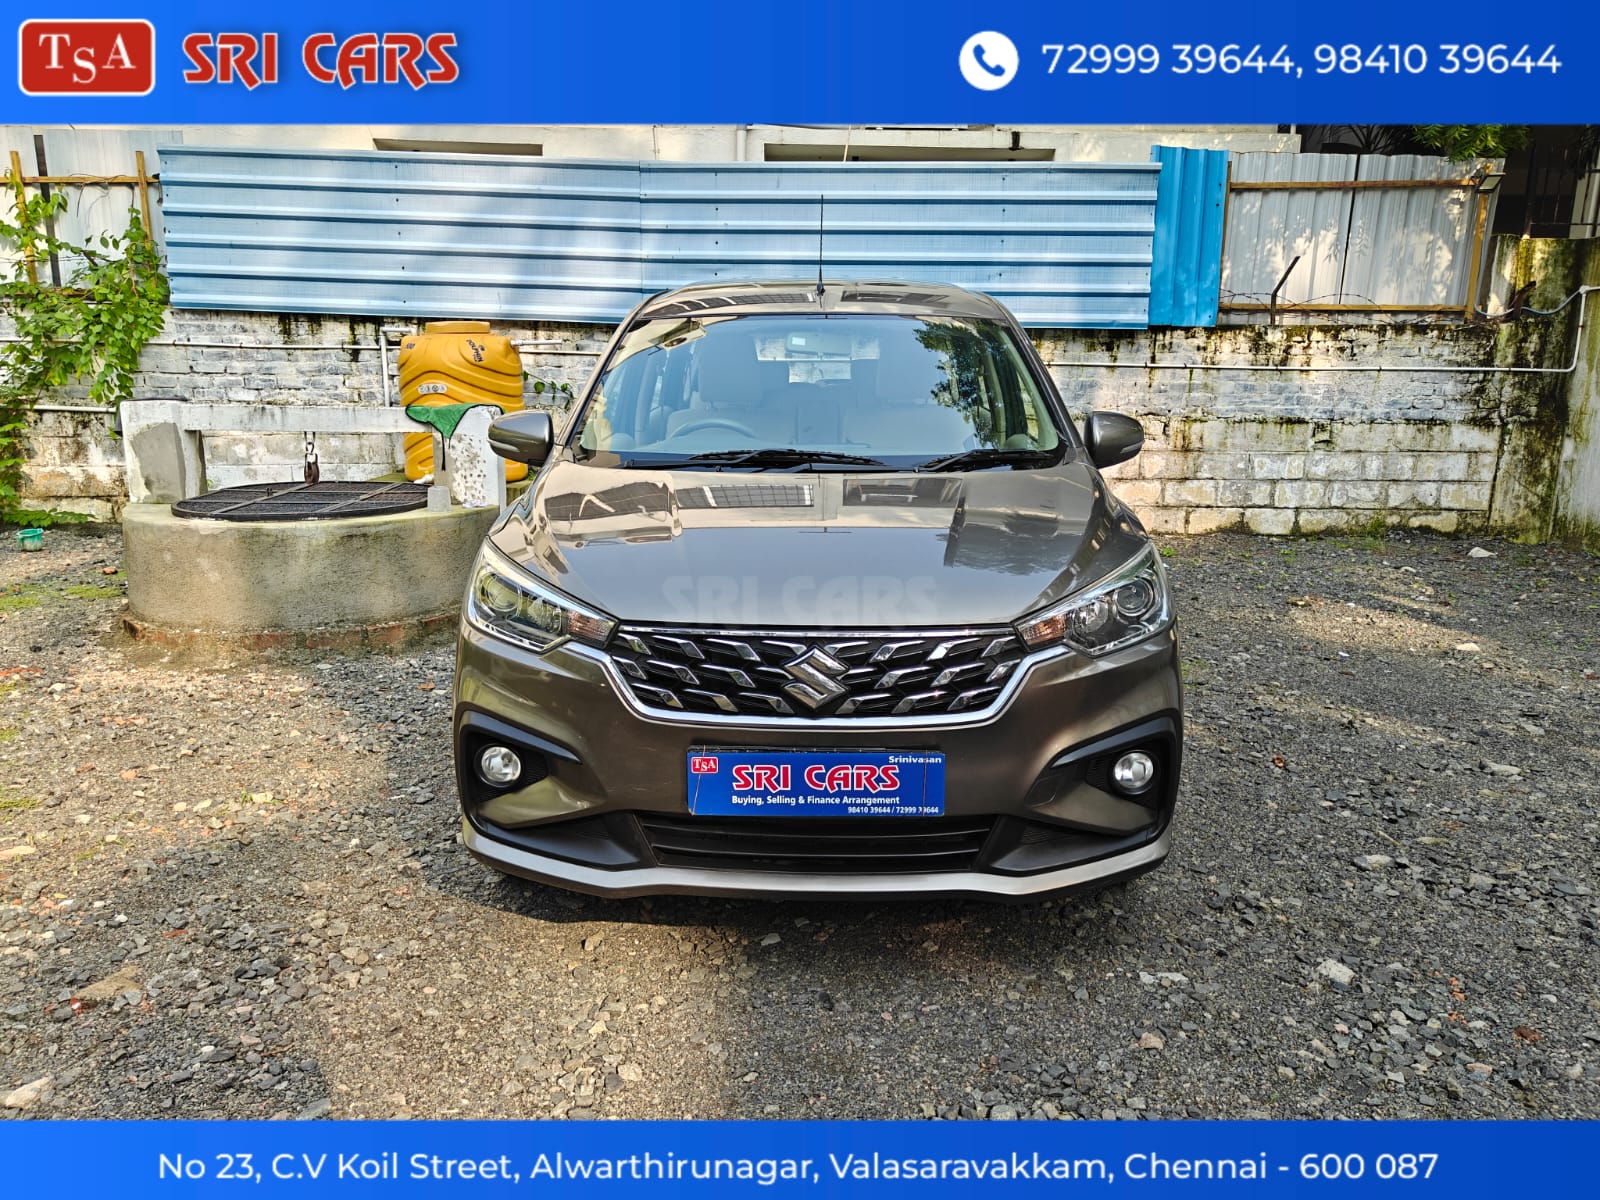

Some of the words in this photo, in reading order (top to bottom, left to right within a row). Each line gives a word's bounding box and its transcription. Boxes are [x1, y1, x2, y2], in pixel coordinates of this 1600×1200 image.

[888, 755, 942, 764] Srinivasan
[732, 764, 792, 794] SRI
[803, 764, 901, 794] CARS
[731, 795, 765, 806] Buying,
[766, 795, 796, 806] Selling
[798, 796, 805, 804] &
[807, 795, 841, 804] Finance
[842, 795, 900, 806] Arrangement
[847, 806, 869, 814] 98410
[870, 806, 891, 814] 39644
[896, 806, 917, 814] 72999
